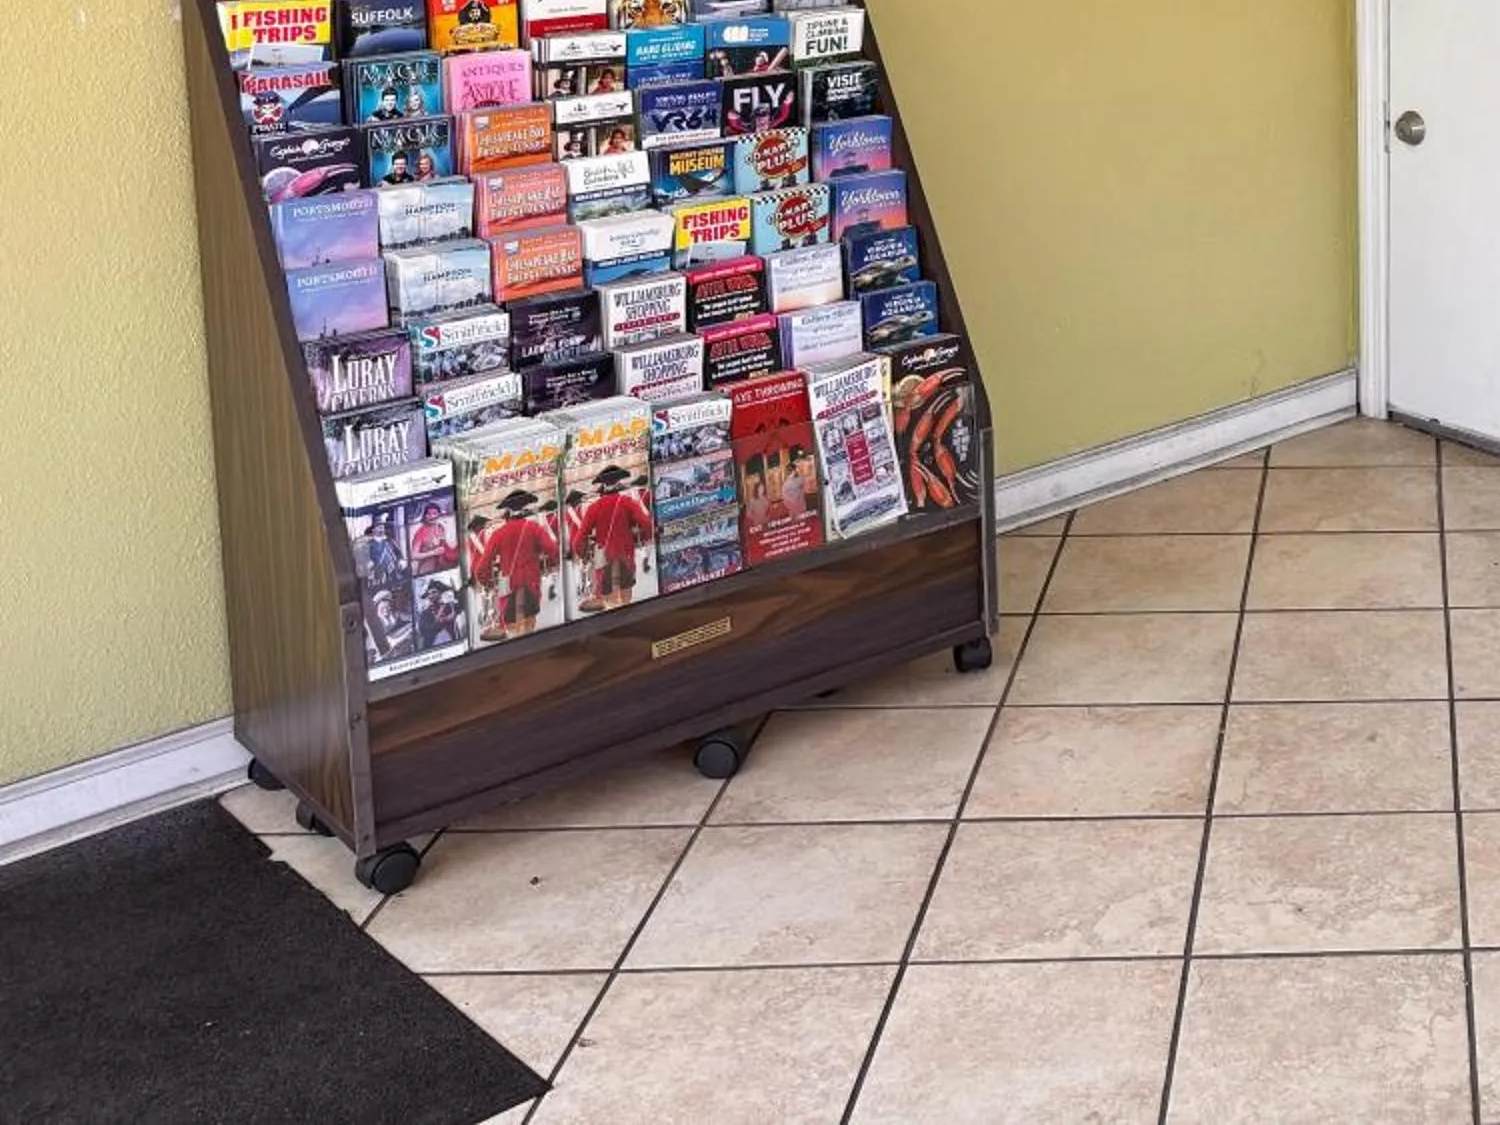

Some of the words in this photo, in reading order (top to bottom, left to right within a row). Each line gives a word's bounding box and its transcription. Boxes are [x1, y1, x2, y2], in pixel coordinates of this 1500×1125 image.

[243, 7, 328, 27] FISHING
[351, 6, 414, 24] SUFFOLK
[253, 26, 317, 44] TRIPS
[806, 37, 848, 55] FUN!
[827, 72, 862, 87] VISIT
[733, 82, 786, 113] FLY
[671, 155, 724, 175] MUSEUM
[682, 207, 748, 230] FISHING
[690, 225, 740, 244] TRIPS
[331, 355, 396, 394] LURAY
[579, 418, 648, 446] MAP
[345, 423, 410, 462] LURAY
[486, 445, 561, 473] MAP
